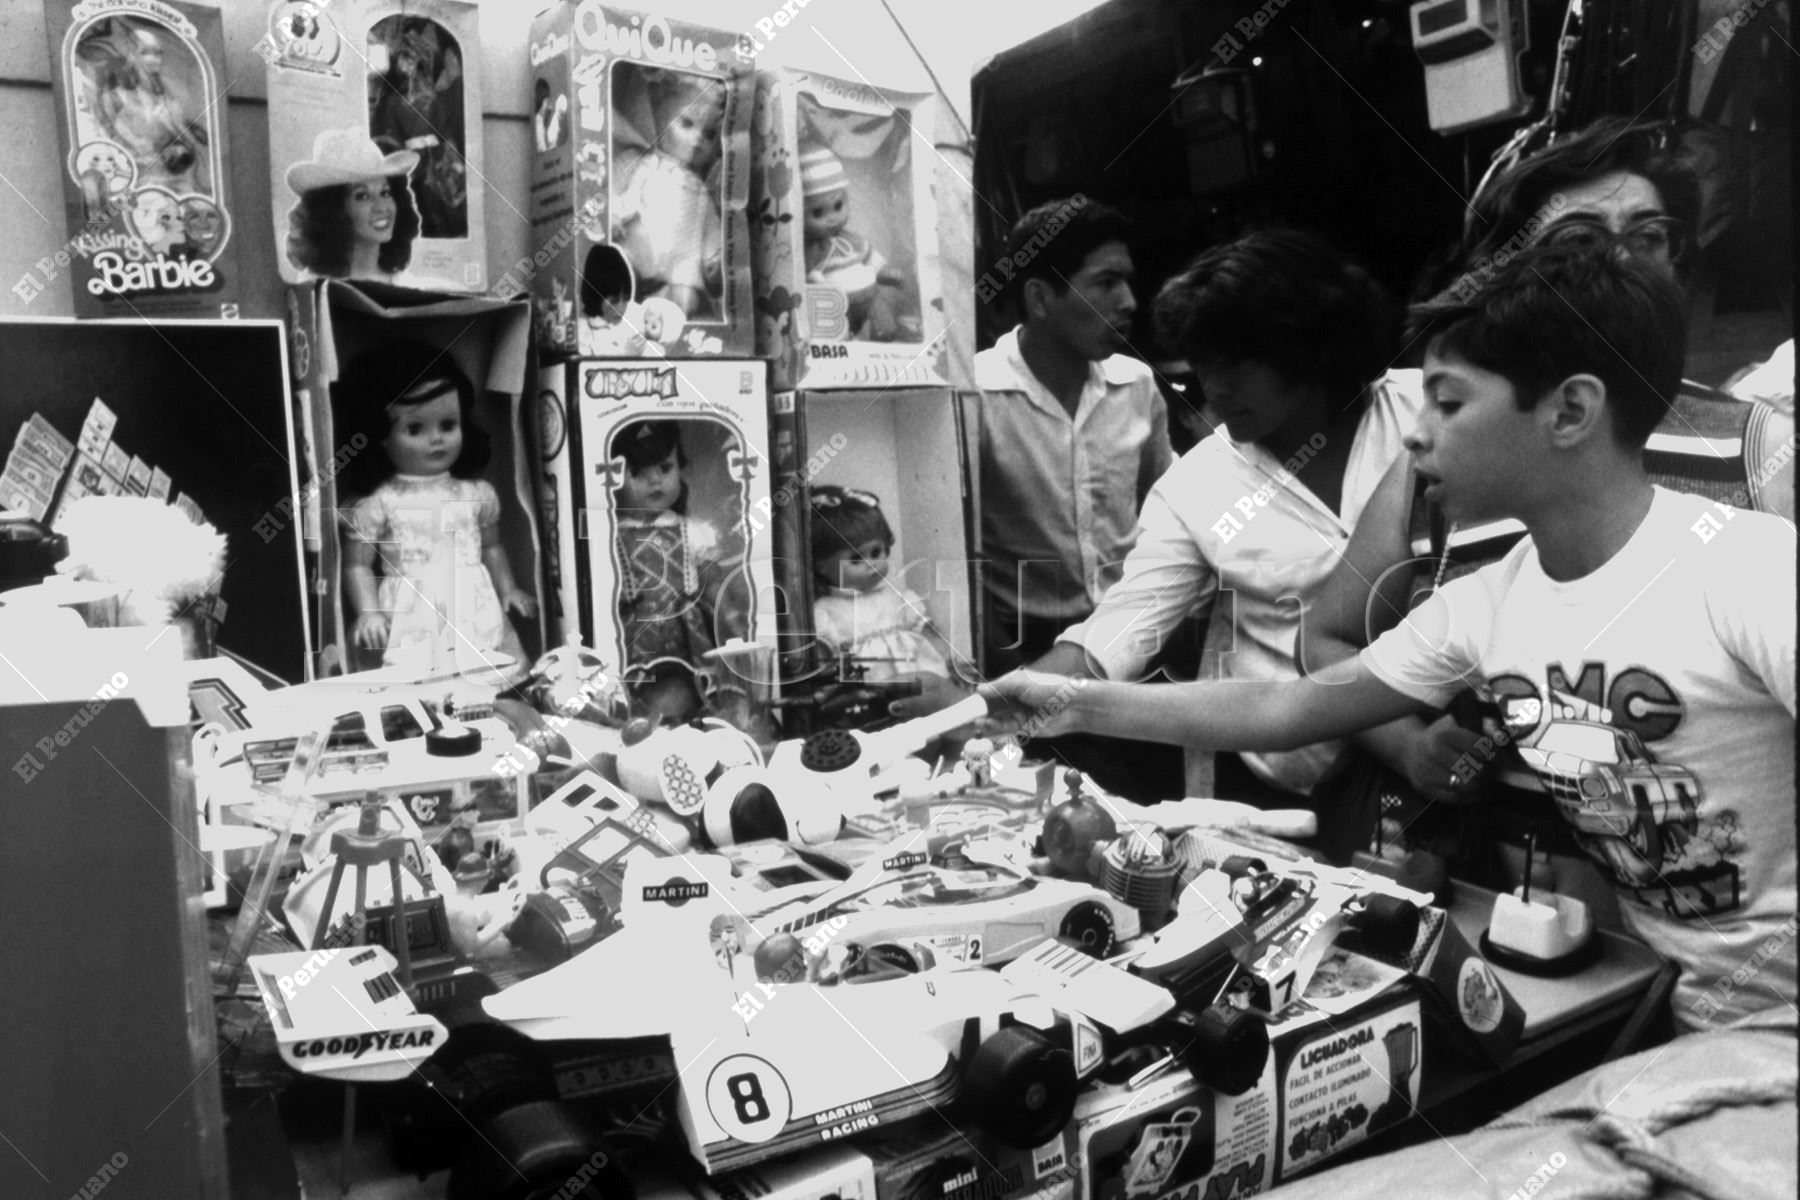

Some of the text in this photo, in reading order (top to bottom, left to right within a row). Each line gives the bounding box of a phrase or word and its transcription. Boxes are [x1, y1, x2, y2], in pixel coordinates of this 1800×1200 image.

[88, 251, 214, 294] Barbie
[811, 344, 848, 359] BASA
[645, 883, 707, 899] MARTINI
[969, 938, 981, 960] 2
[1275, 970, 1296, 1004] 7
[292, 1029, 434, 1059] GOODYEAR
[727, 1072, 771, 1125] 8
[1288, 1085, 1329, 1110] CONTACTO
[815, 1099, 873, 1125] MARTINI
[821, 1114, 879, 1141] RACING
[1037, 1153, 1064, 1174] BASA
[943, 1165, 978, 1194] mini
